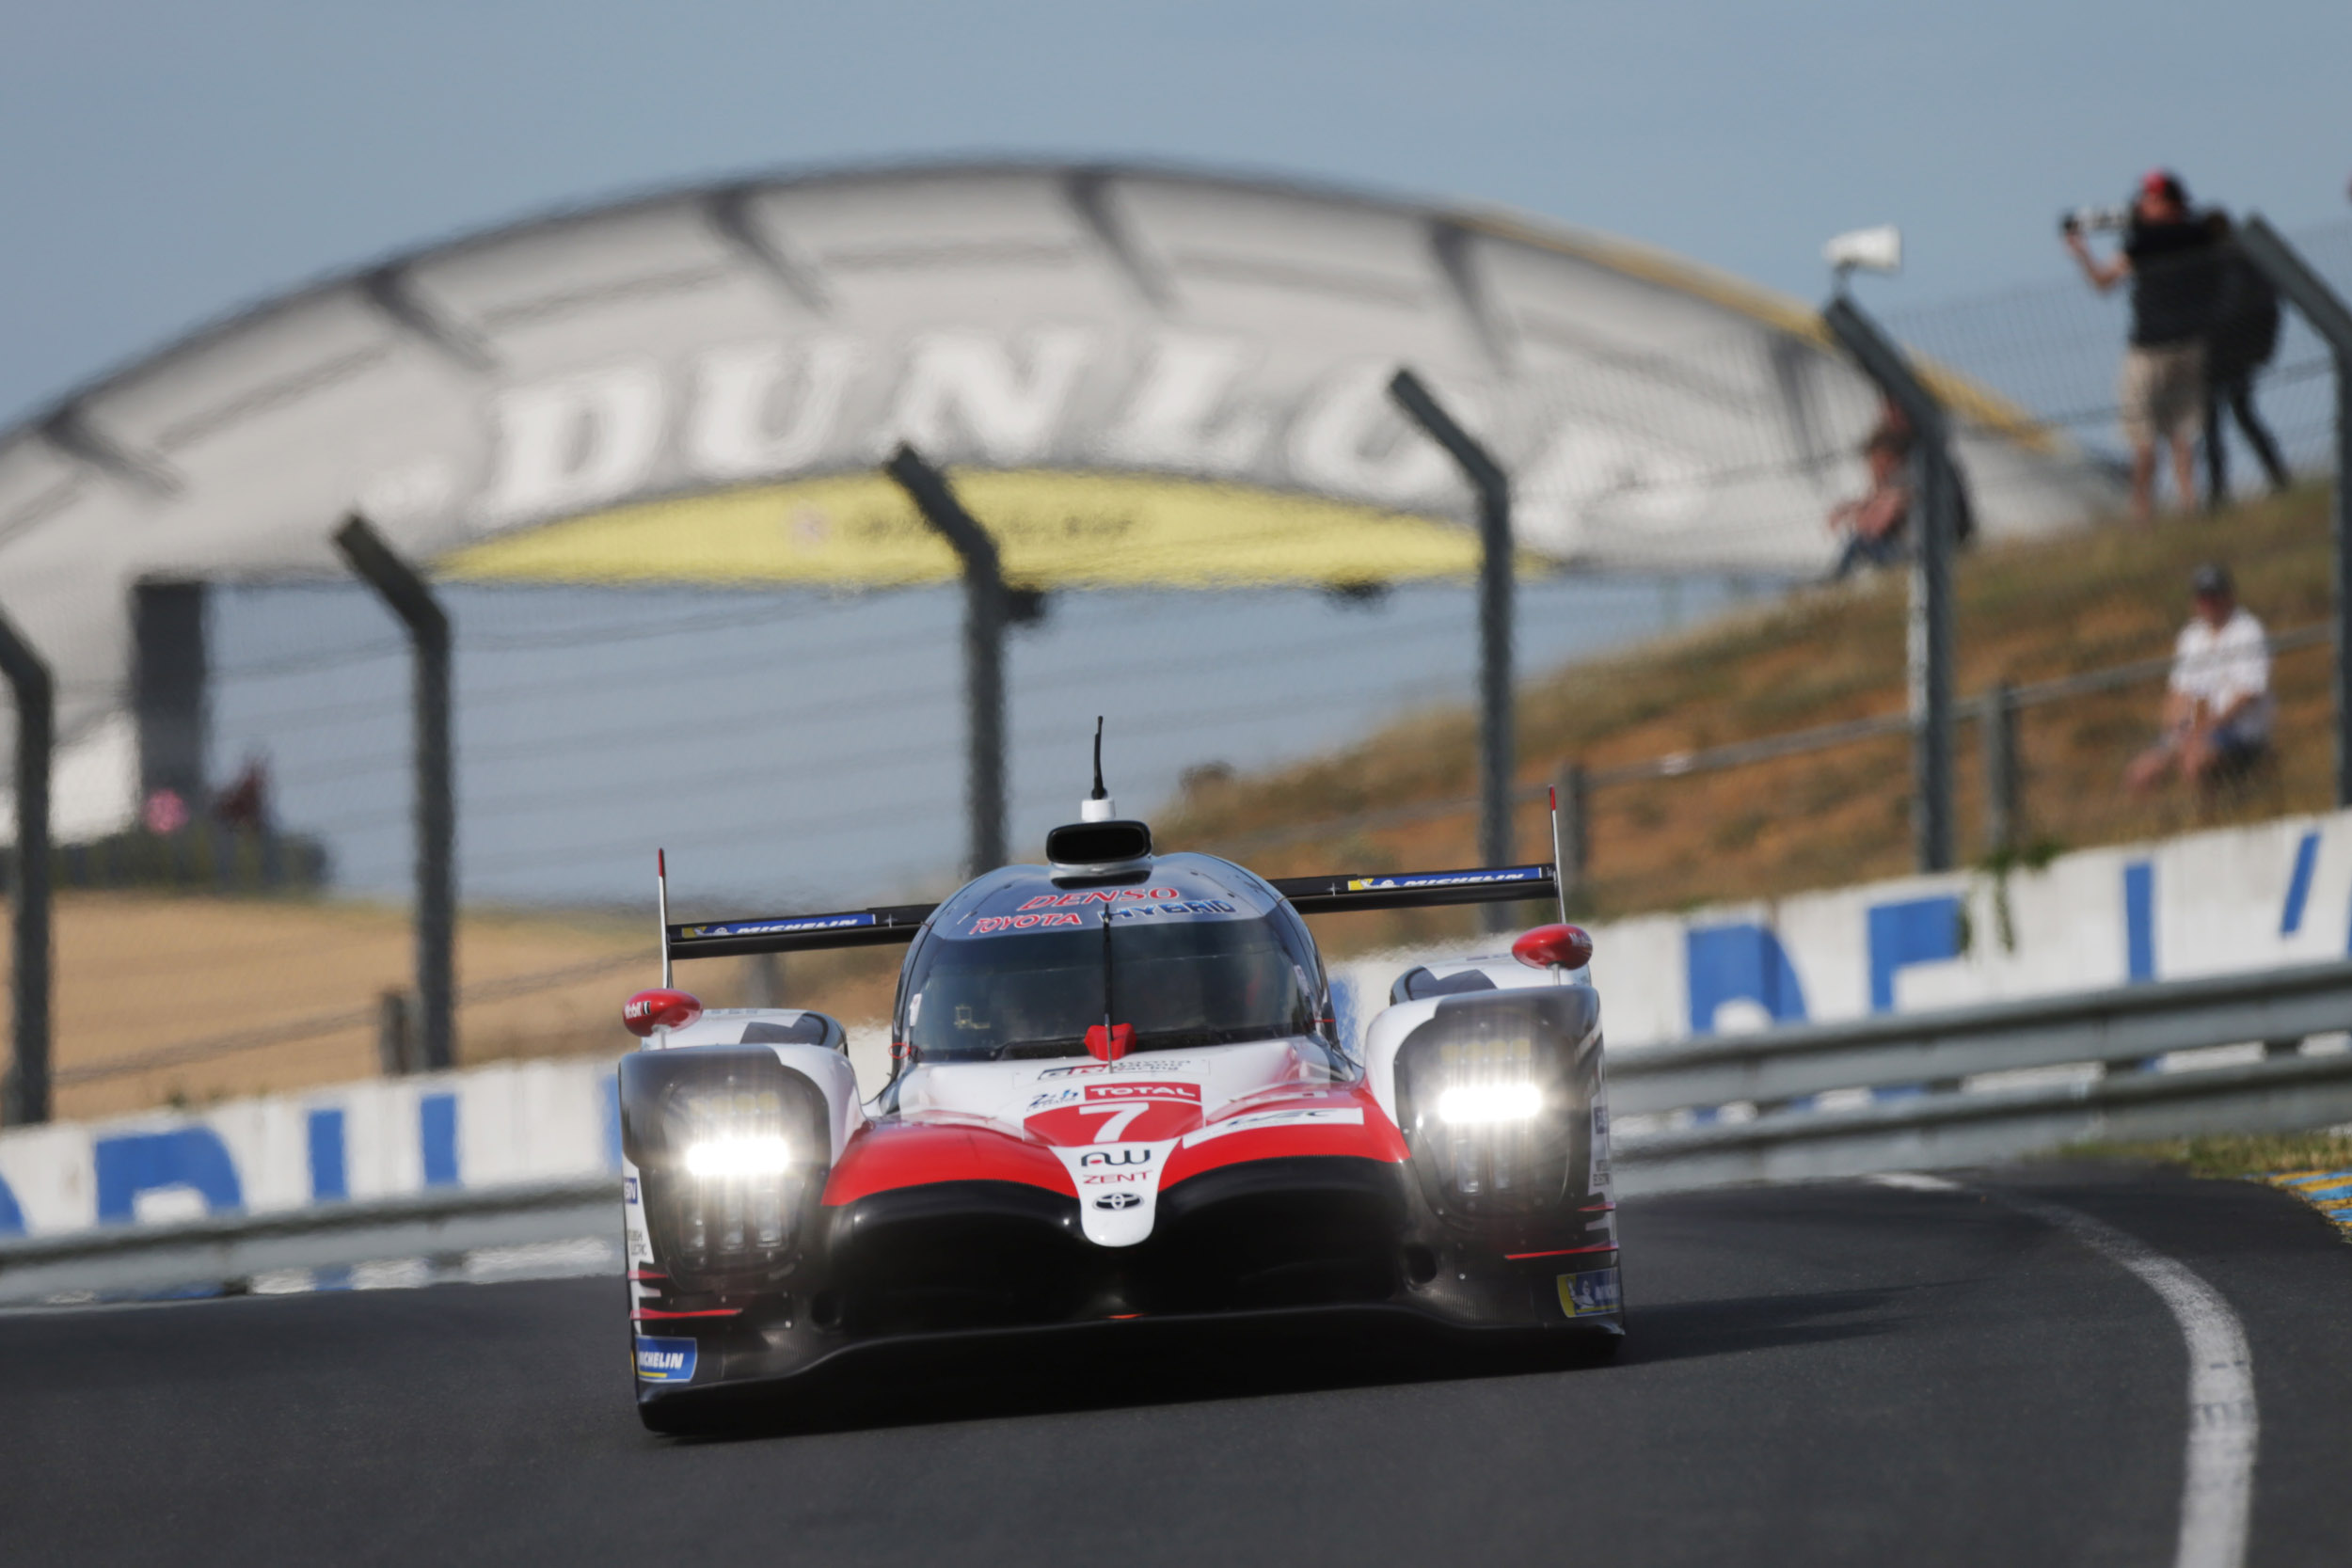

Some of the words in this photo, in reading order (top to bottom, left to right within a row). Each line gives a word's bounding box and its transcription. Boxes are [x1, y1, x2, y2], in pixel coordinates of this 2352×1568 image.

[1404, 873, 1525, 886] MICHELIN
[1017, 887, 1180, 911] DENSO
[969, 912, 1082, 935] TOYOTA
[1097, 898, 1237, 922] HYBRID
[736, 918, 858, 934] MICHELIN
[1089, 1086, 1197, 1099] TOTAL
[1078, 1101, 1150, 1144] 7
[1083, 1169, 1153, 1185] ZENT
